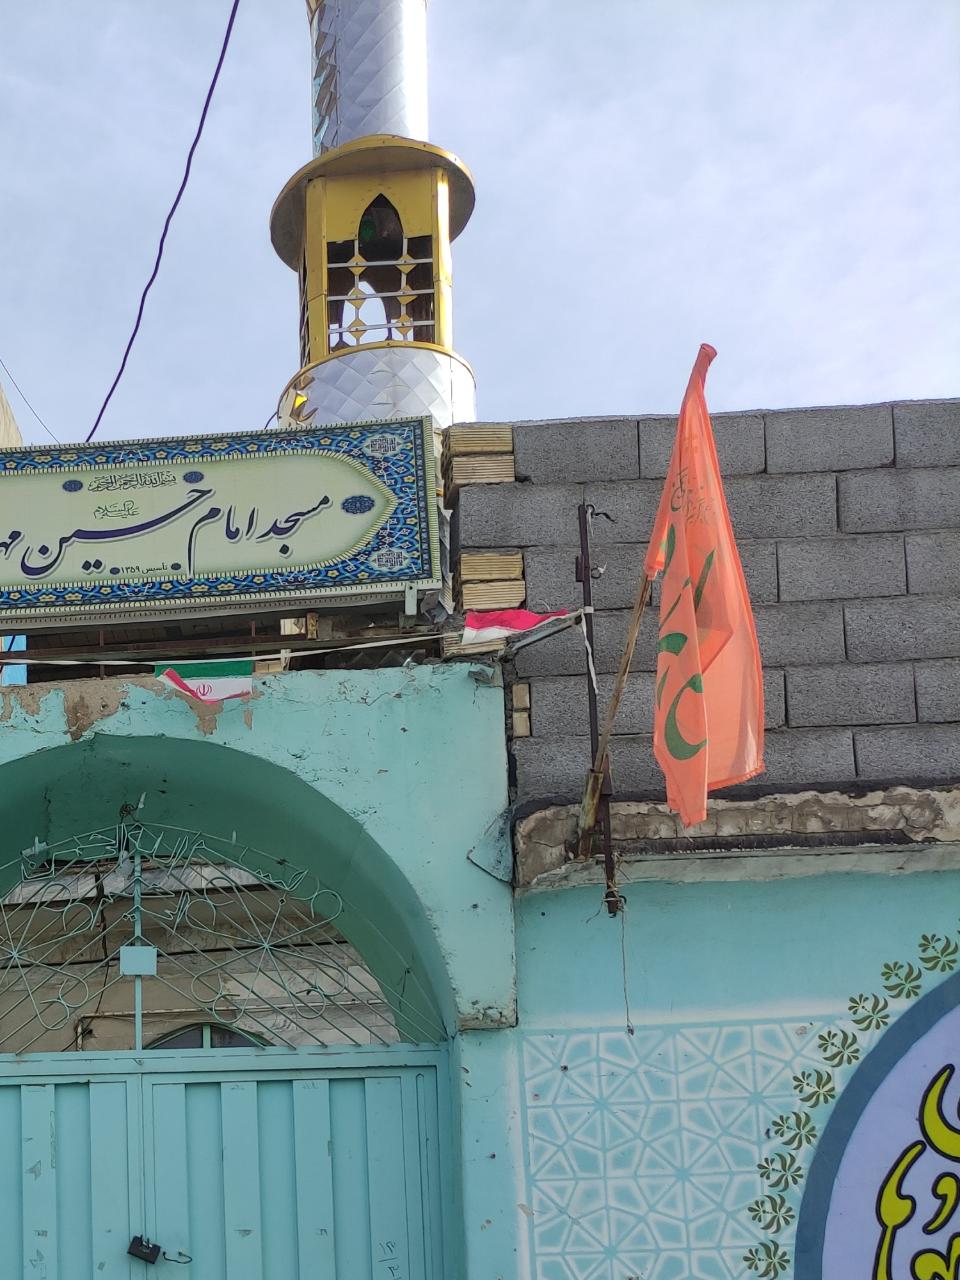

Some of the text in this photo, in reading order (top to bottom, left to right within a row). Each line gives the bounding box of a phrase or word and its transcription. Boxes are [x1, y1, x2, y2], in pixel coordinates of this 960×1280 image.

[20, 488, 213, 577] حسین
[188, 504, 256, 576] امام
[256, 495, 331, 555] مسجد
